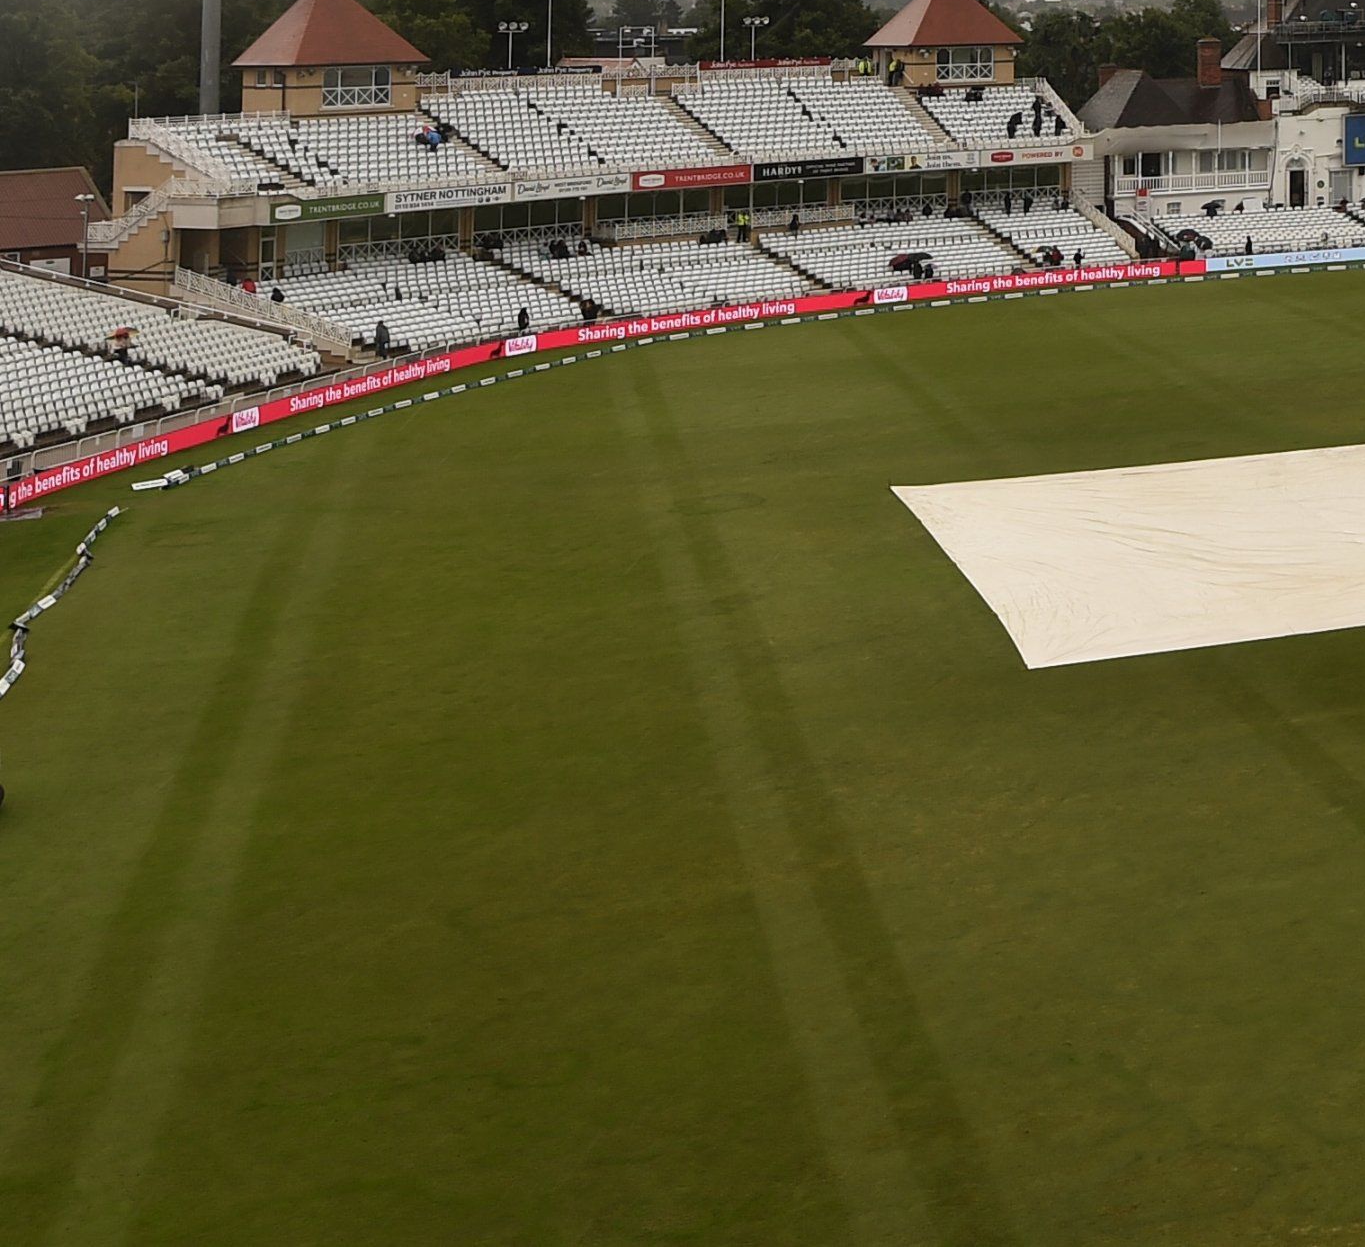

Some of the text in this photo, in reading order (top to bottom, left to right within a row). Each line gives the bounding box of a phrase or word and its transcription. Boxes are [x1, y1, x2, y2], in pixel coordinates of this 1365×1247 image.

[675, 170, 745, 183] TRENTBRIDGE.CO.UK
[309, 200, 379, 214] TRENTBRIDGE.CO.UK
[395, 191, 436, 203] SYTNER
[439, 186, 506, 199] NOTTINGHAM
[946, 263, 1160, 294] Sharing the benefits of healthy living
[578, 303, 795, 341] Sharing the benefits of healthy living
[290, 356, 450, 412] Sharing the benefits of healthy living
[18, 482, 32, 500] the
[34, 467, 81, 493] benefits
[82, 463, 96, 477] of
[96, 447, 136, 473] healthy
[138, 439, 168, 459] living
